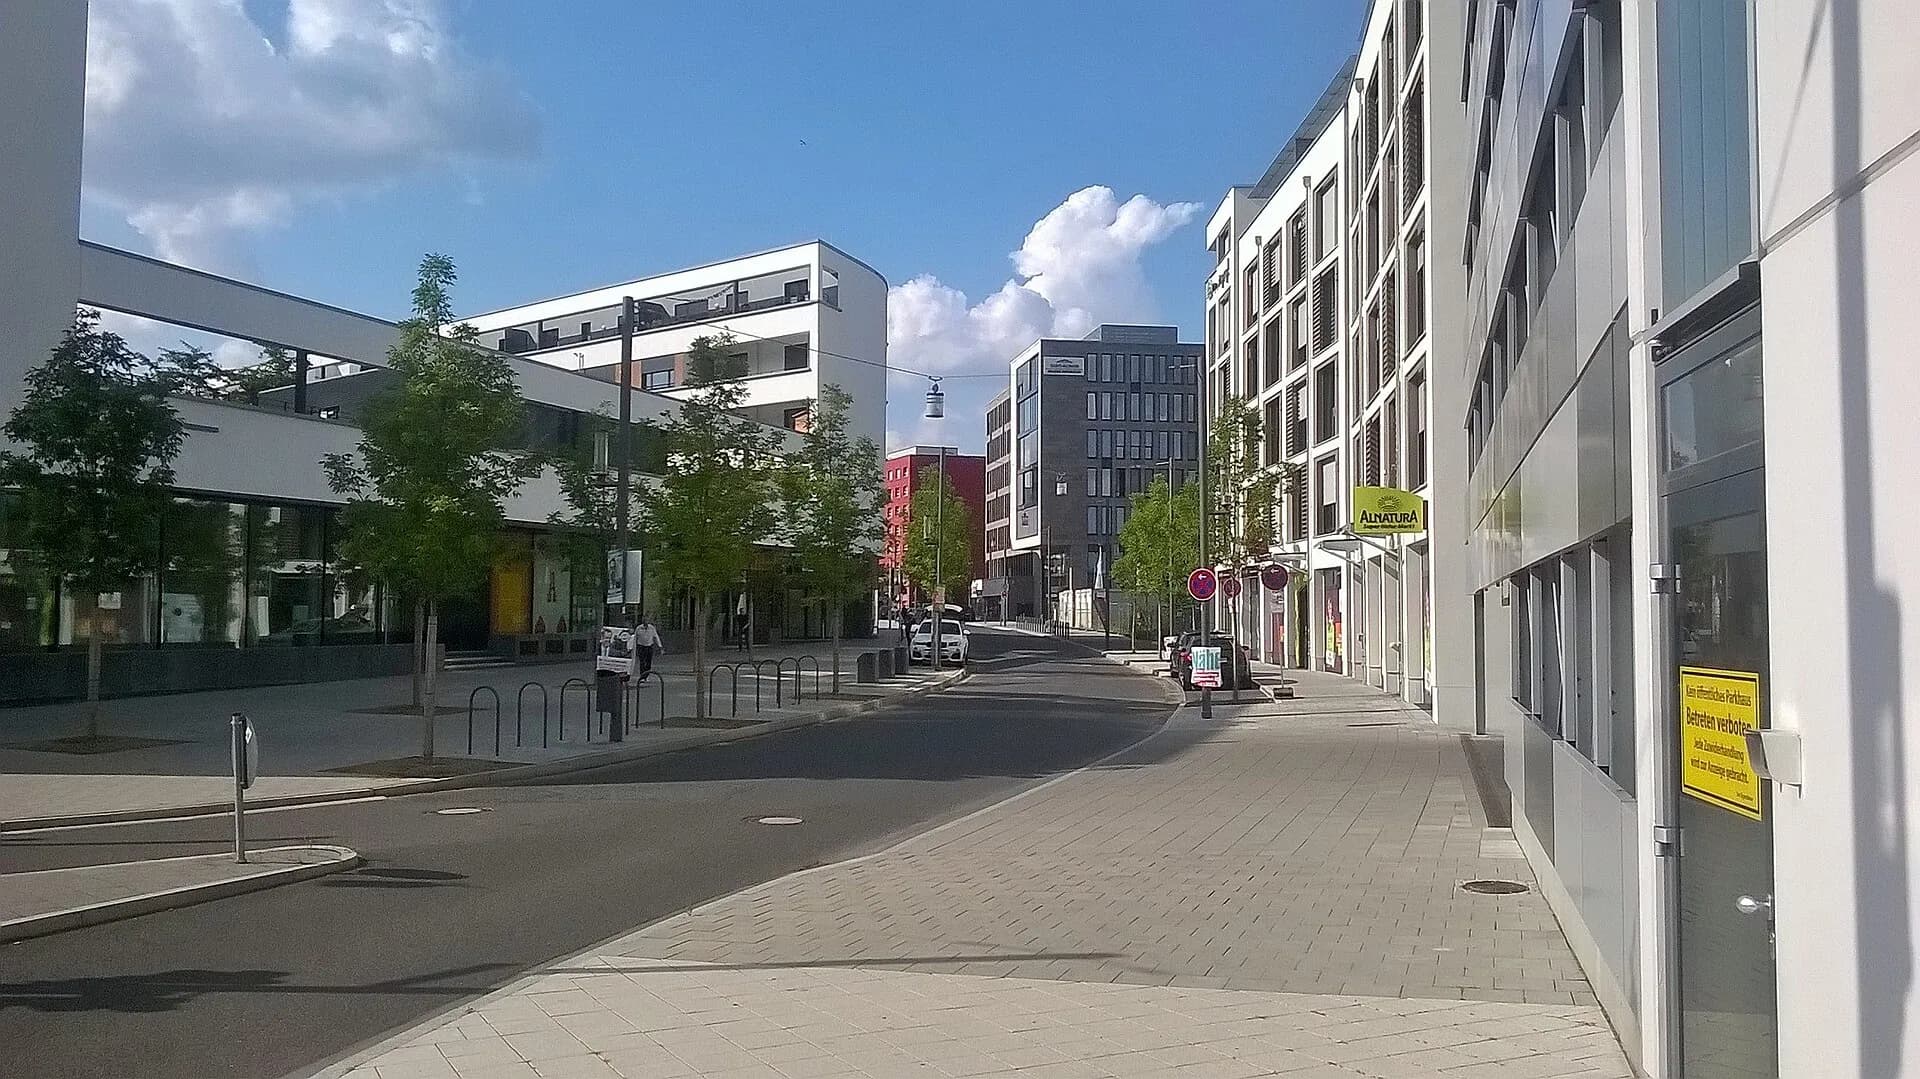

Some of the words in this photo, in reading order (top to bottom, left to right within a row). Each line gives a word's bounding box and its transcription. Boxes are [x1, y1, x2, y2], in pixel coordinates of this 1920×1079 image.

[1360, 510, 1418, 523] ALNATURA
[1686, 685, 1696, 698] Kein
[1697, 685, 1725, 703] öffentliches
[1726, 689, 1752, 707] Parkhaus
[1686, 706, 1716, 730] Betreten
